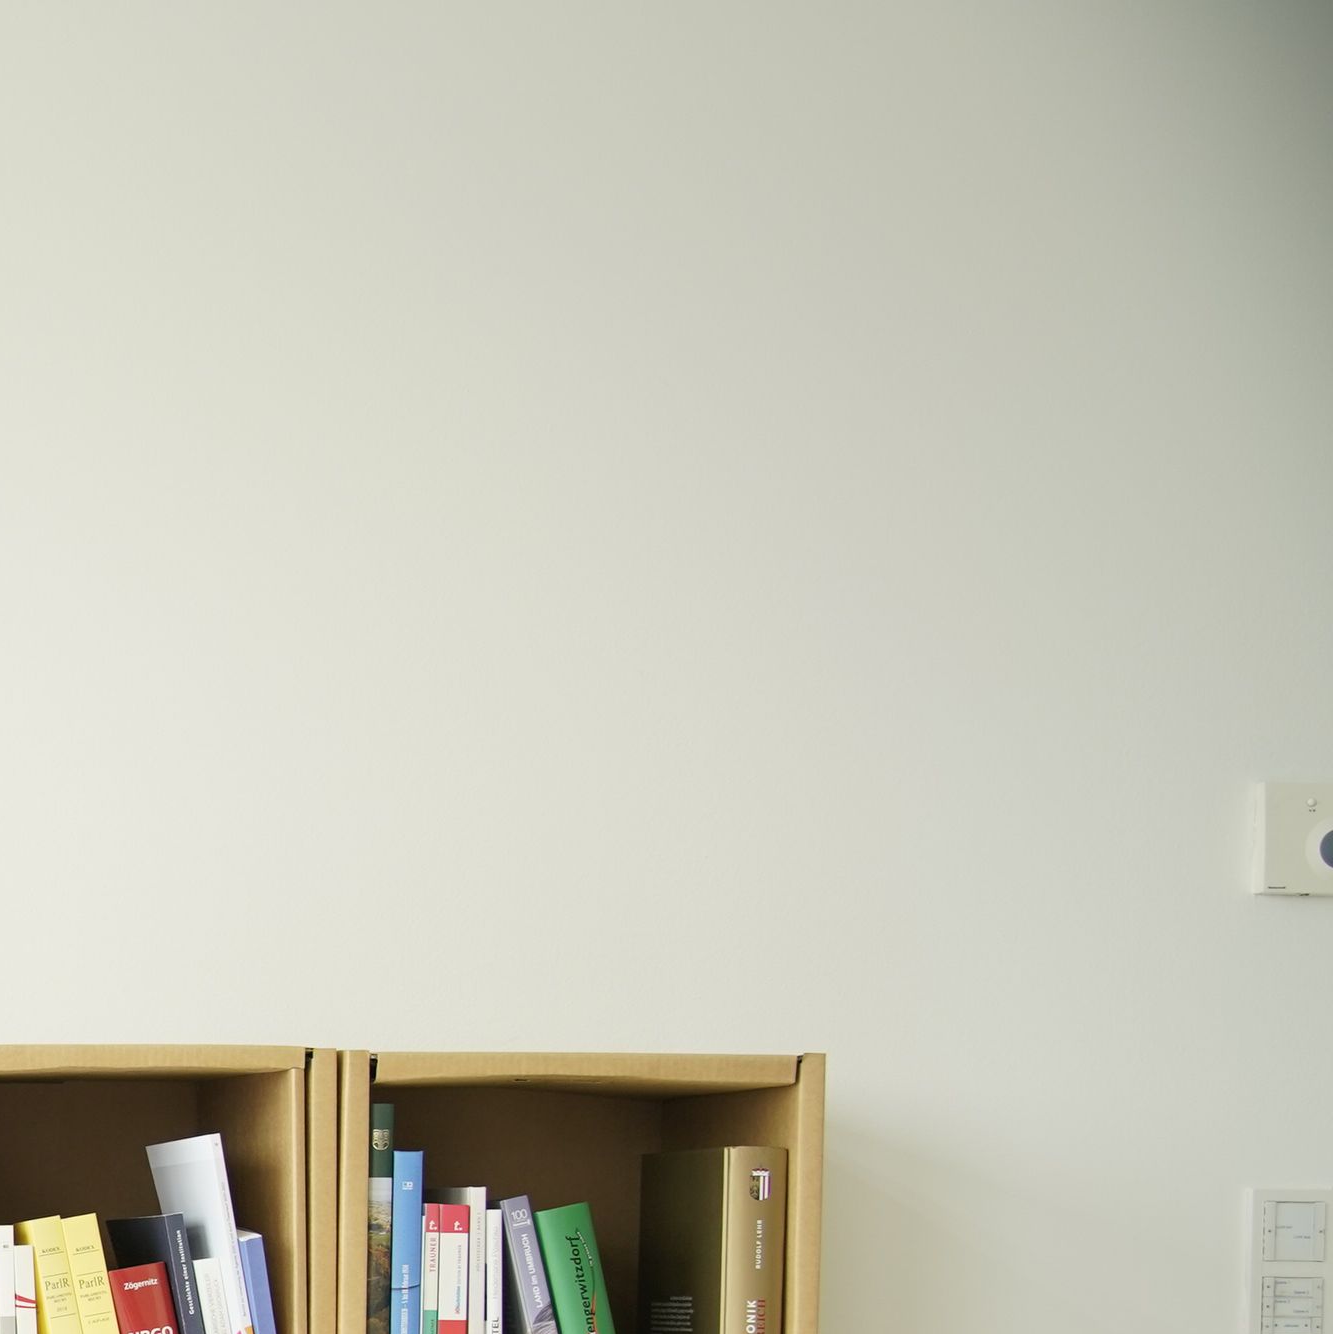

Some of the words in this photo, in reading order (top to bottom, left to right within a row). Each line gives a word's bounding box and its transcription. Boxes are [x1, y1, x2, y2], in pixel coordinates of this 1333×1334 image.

[175, 1230, 188, 1262] Institution
[428, 1237, 438, 1273] TRAUNER
[521, 1233, 536, 1275] UMBRUCH
[755, 1241, 763, 1270] RUDOLF
[44, 1277, 71, 1292] ParlR
[78, 1275, 106, 1291] ParlR
[122, 1277, 159, 1291] Zögernitz
[183, 1281, 196, 1315] Geschichte
[564, 1231, 597, 1333] engerwitzdorf
